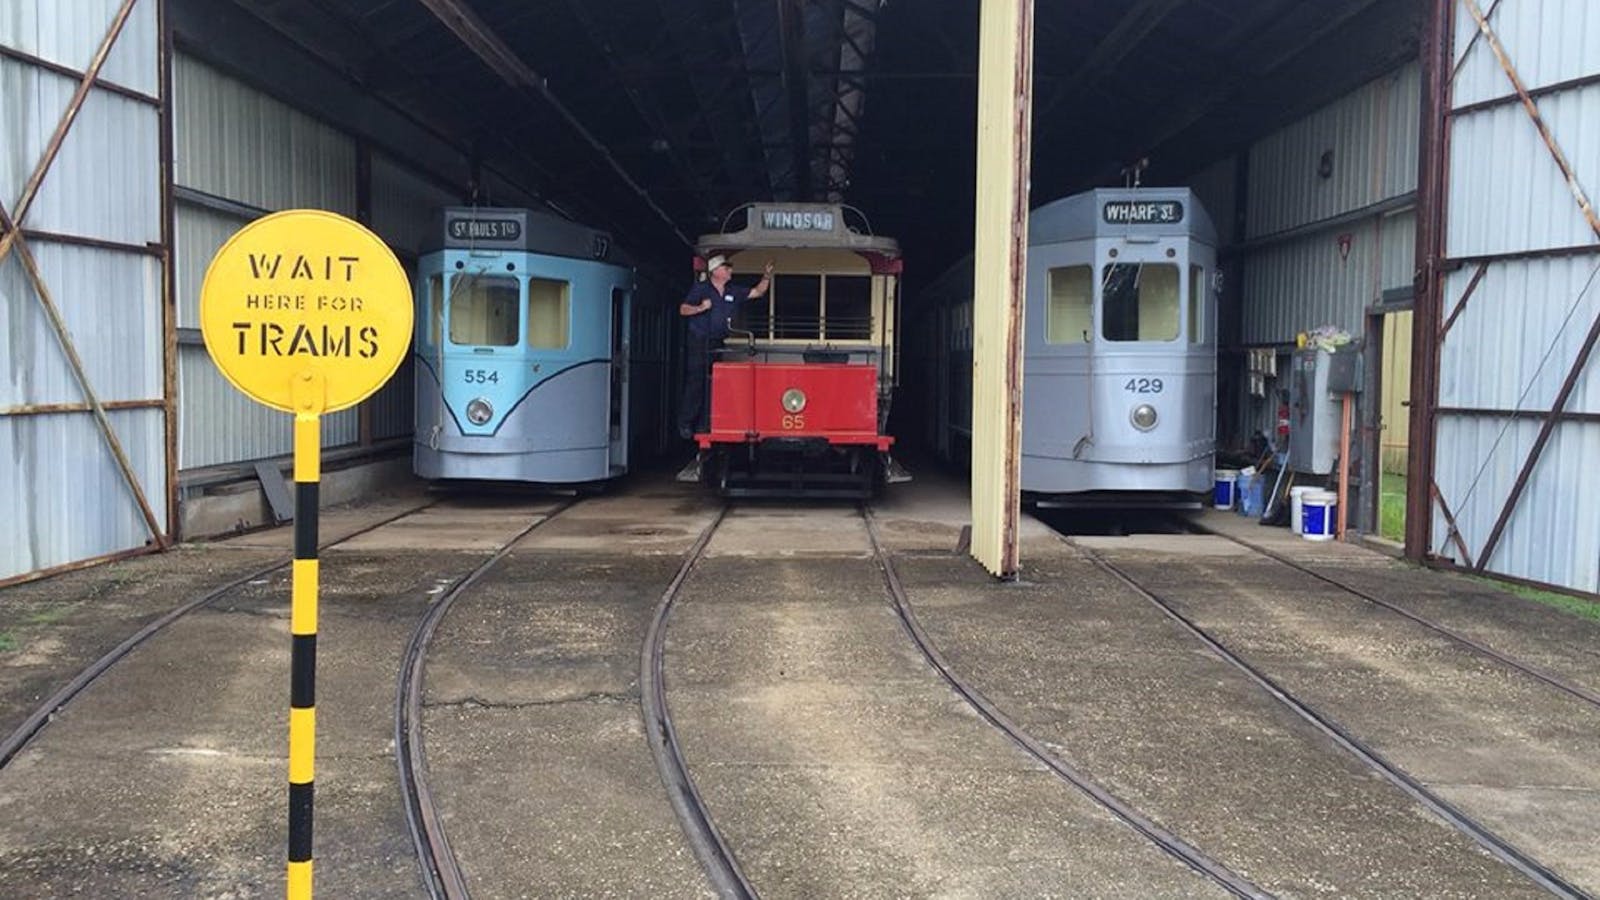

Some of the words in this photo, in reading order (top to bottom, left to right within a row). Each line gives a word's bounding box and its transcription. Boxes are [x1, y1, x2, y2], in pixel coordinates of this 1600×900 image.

[1106, 203, 1155, 220] WHARF
[763, 211, 833, 231] WINDSOR
[248, 253, 359, 282] WAIT
[246, 294, 305, 310] HERE
[317, 295, 364, 311] FOR
[232, 321, 379, 359] TRAMS
[464, 369, 499, 384] 554
[1124, 378, 1163, 393] 429
[782, 415, 805, 430] 65
